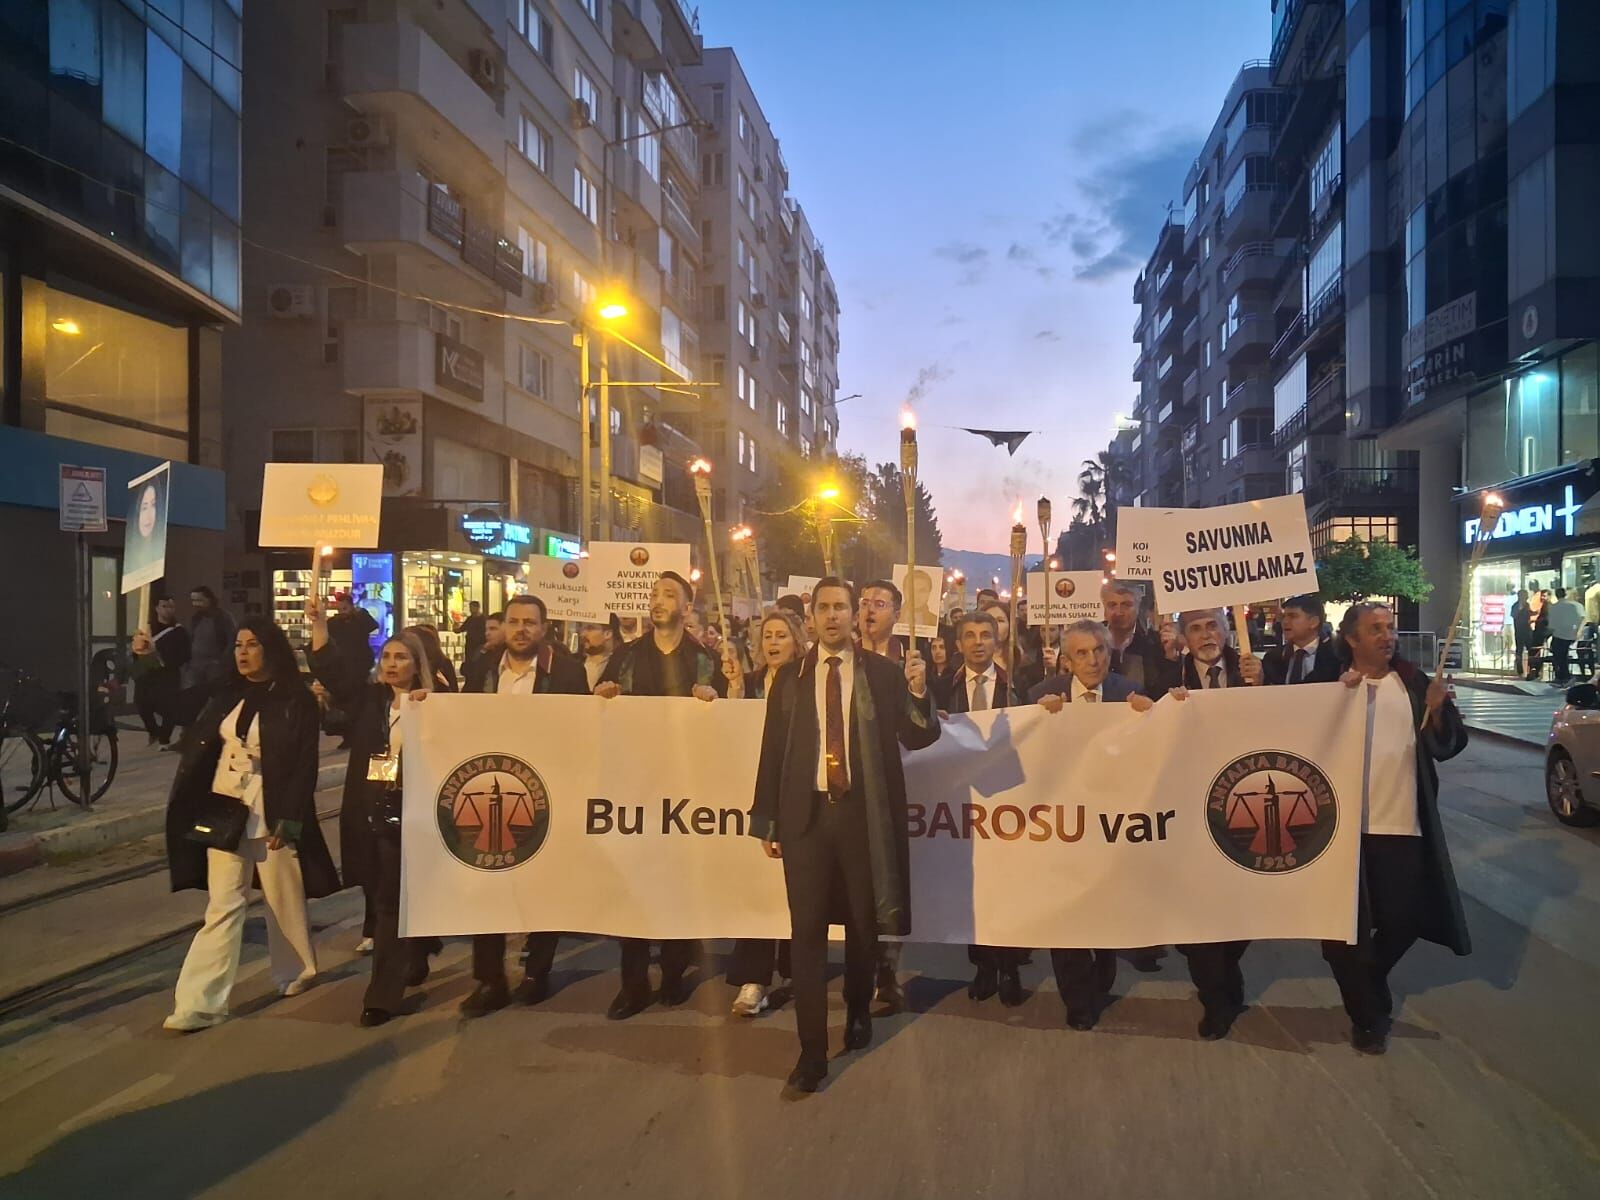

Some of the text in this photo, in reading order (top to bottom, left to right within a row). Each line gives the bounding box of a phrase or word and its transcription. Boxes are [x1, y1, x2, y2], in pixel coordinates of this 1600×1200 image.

[1186, 521, 1273, 554] SAVUNMA
[606, 579, 625, 589] SESİ
[1163, 552, 1307, 593] SUSTURULAMAZ
[604, 601, 634, 611] NEFESİ
[440, 757, 547, 811] ANTALYA BAROSU
[1209, 755, 1332, 812] ANTALYA BAROSU
[585, 798, 1176, 843] Bu Ken BAROSU var
[474, 851, 517, 868] 1926
[1254, 852, 1297, 870] 1926
